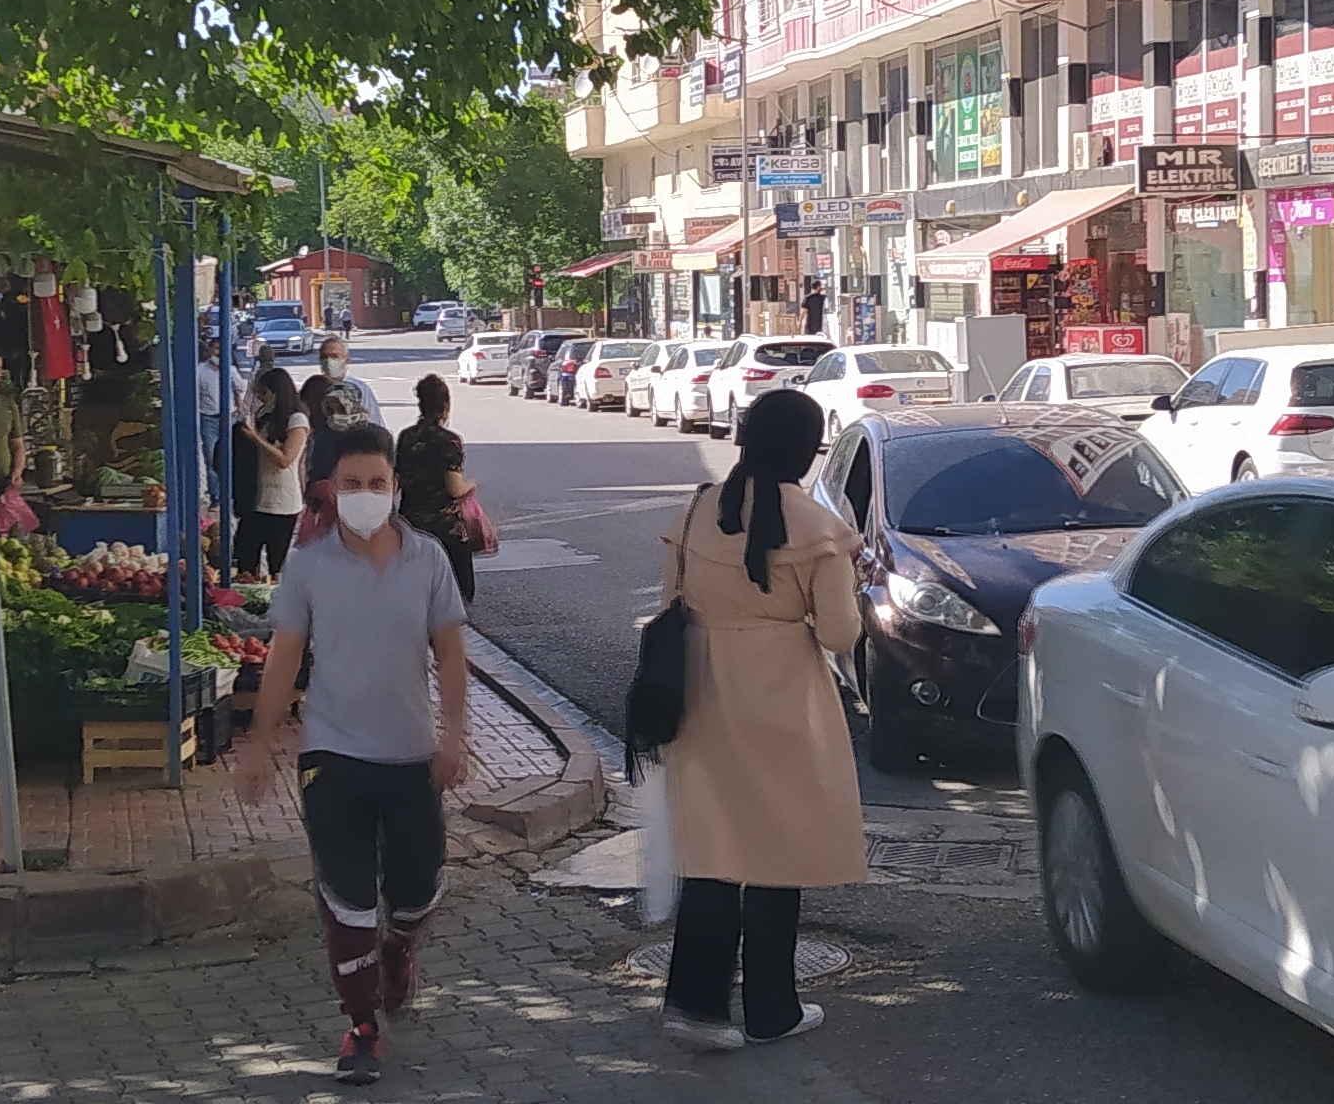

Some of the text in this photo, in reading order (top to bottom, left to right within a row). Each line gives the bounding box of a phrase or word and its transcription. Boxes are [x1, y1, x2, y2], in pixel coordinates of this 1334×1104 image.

[1156, 147, 1224, 166] MİR
[1146, 166, 1236, 185] ELEKTRİK
[817, 201, 849, 212] LED
